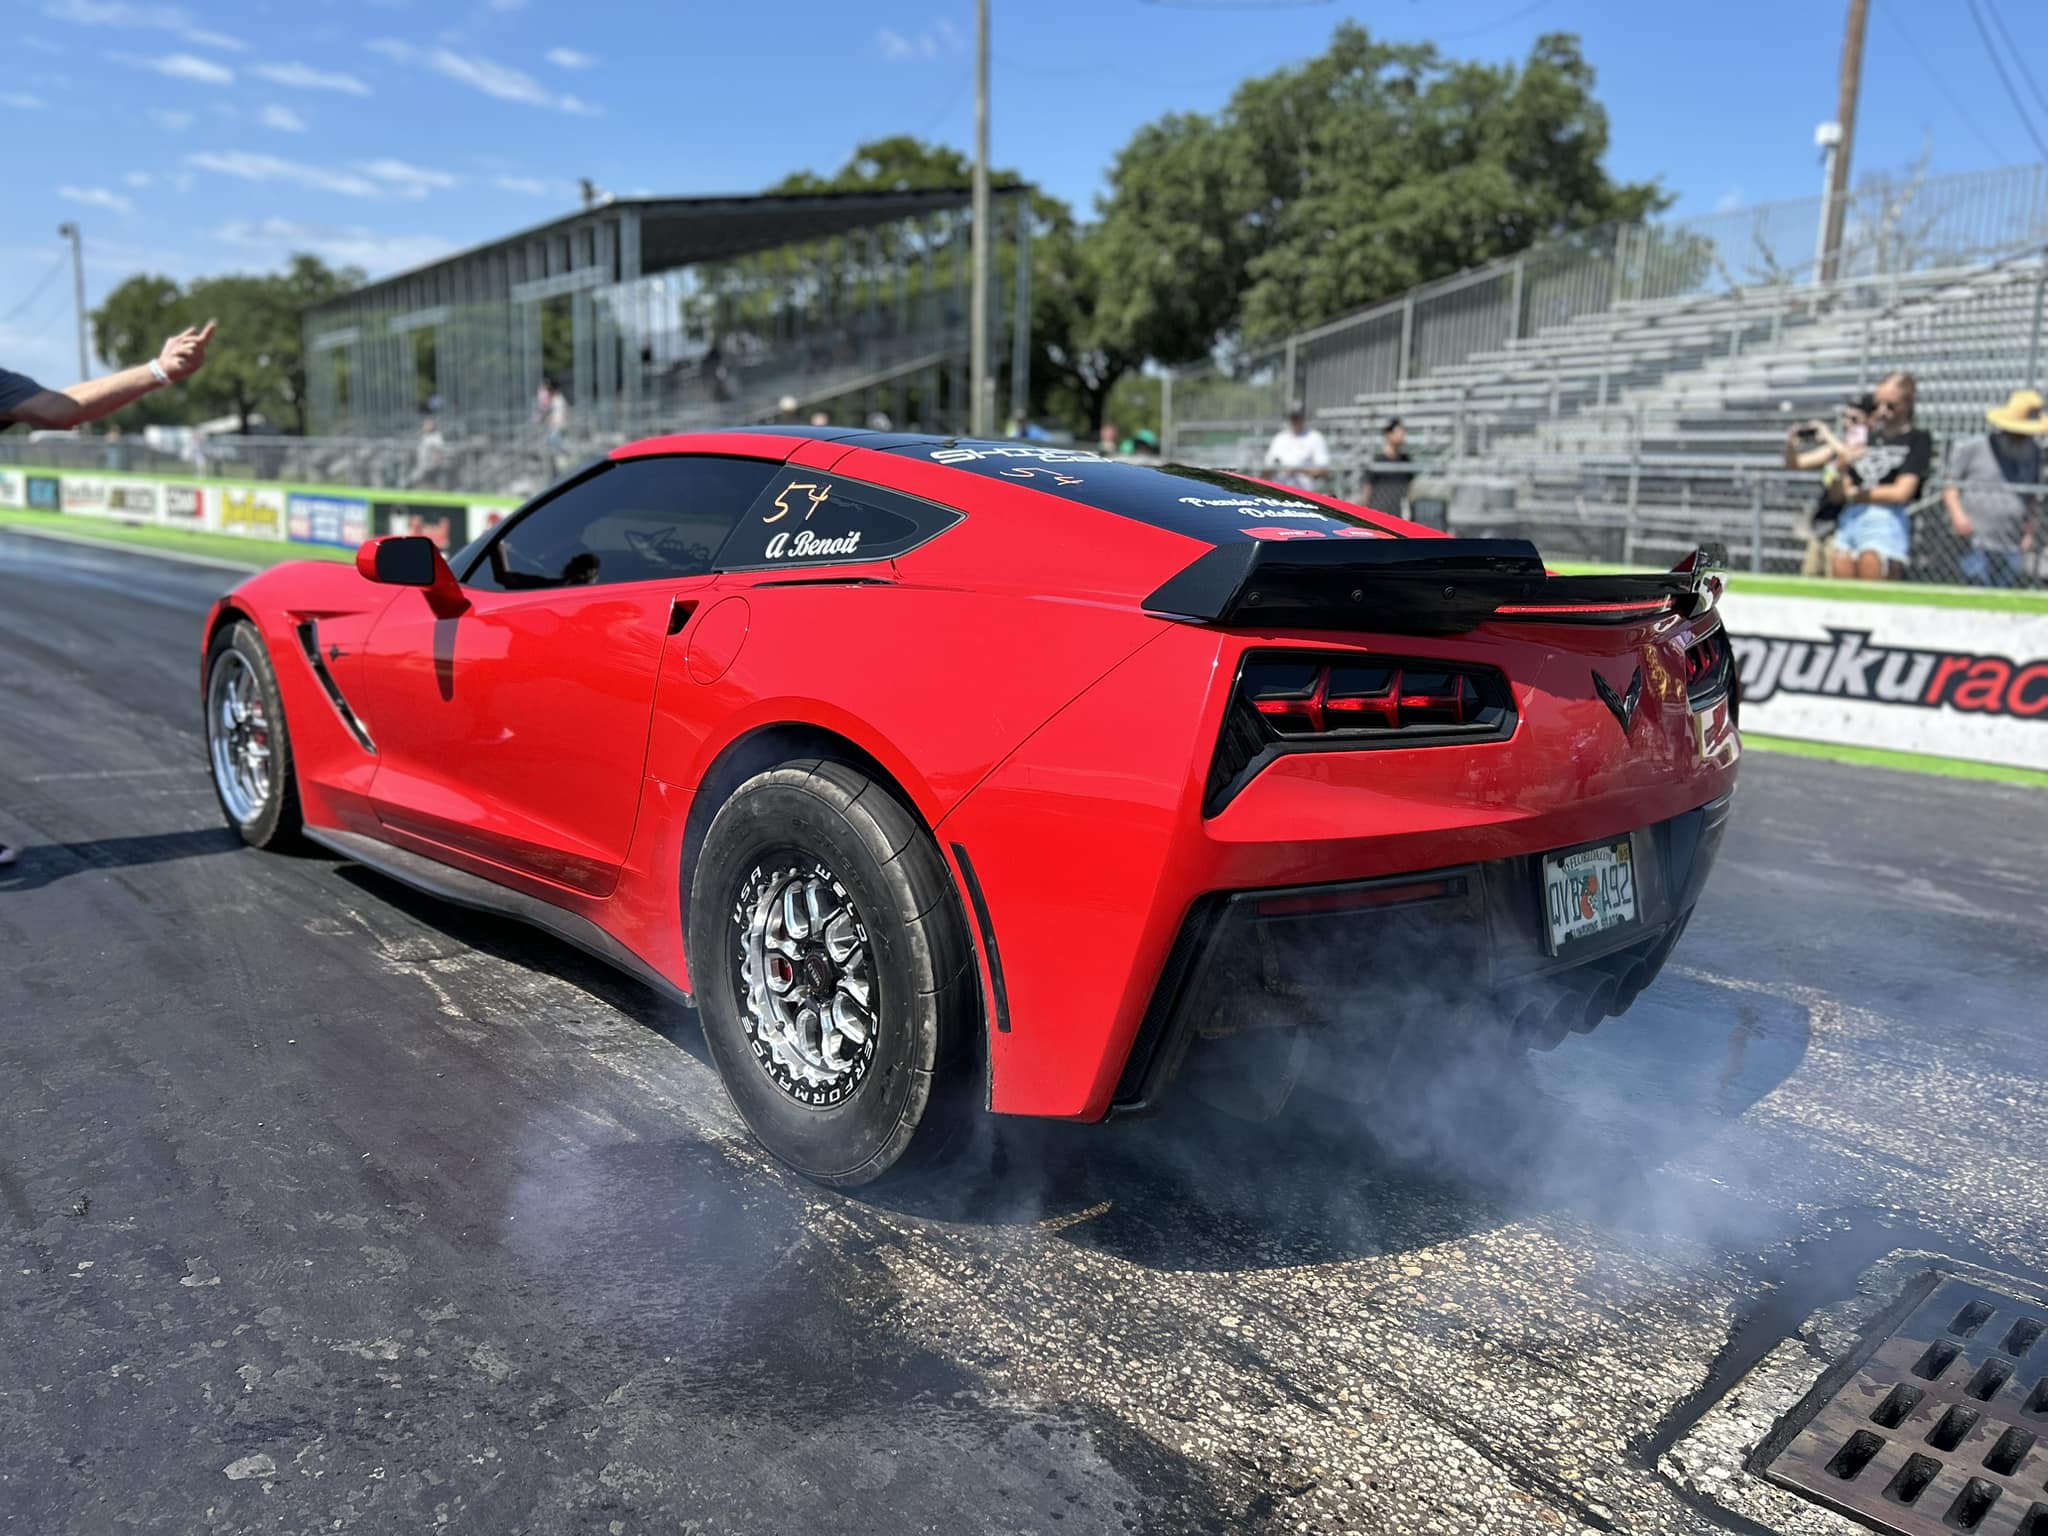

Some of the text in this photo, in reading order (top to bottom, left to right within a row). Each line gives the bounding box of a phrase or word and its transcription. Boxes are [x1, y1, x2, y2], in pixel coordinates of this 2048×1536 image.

[763, 481, 832, 523] 54
[765, 530, 862, 559] A Benoit
[733, 865, 763, 924] USA
[1602, 863, 1632, 911] A92
[741, 1011, 879, 1105] PERFORMANCE
